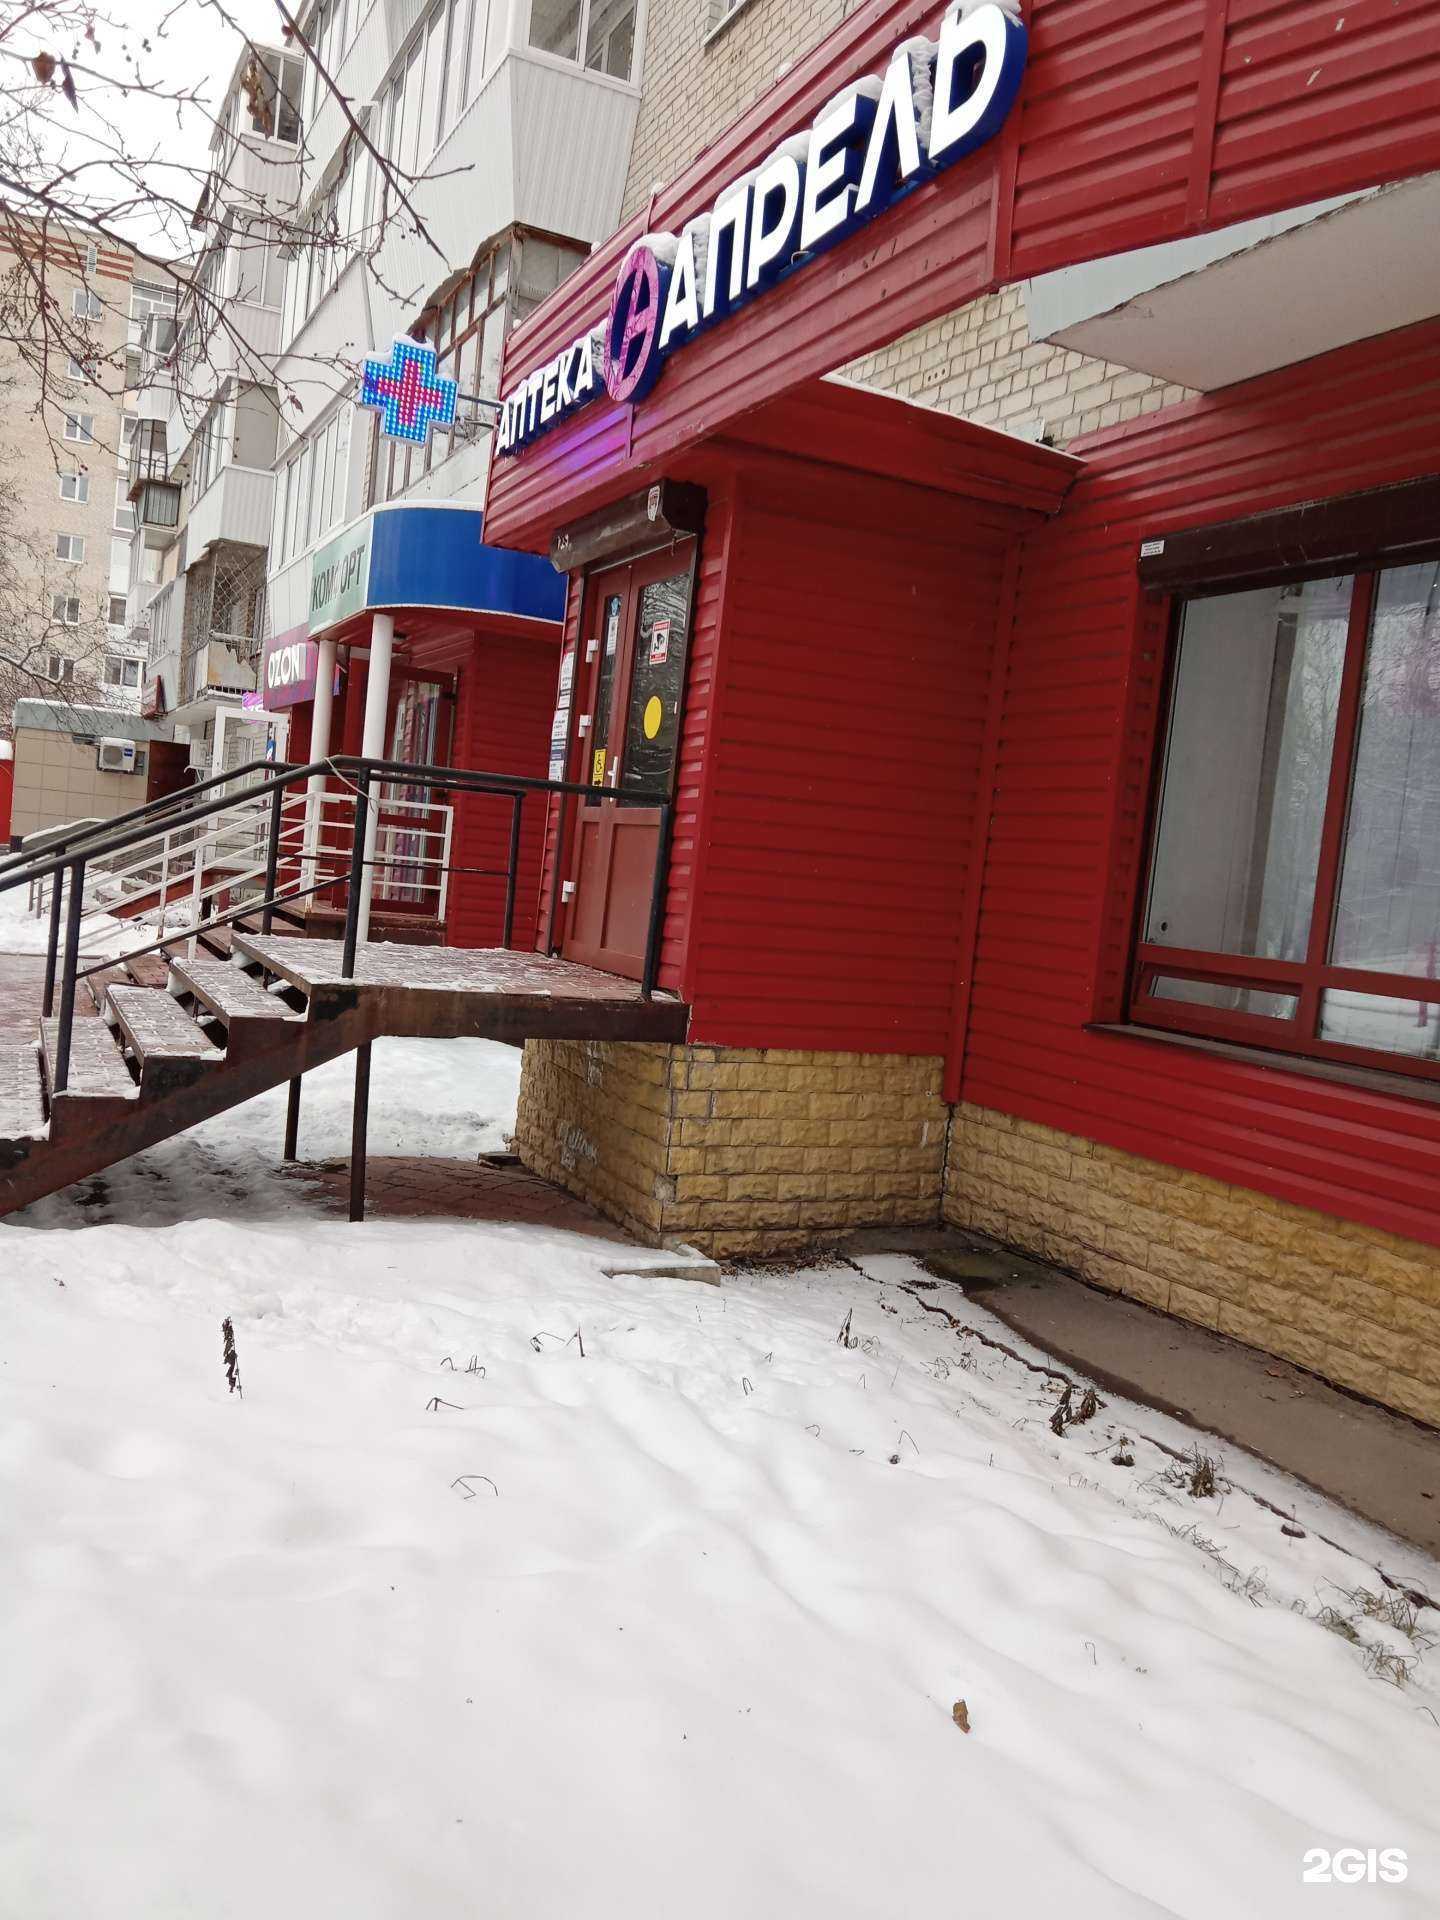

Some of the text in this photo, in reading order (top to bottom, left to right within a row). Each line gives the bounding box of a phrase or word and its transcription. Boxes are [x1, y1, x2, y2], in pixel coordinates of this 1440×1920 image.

[495, 4, 1008, 457] АПТЕКА АПРЕЛЬ
[311, 544, 366, 612] КОМОРТ
[267, 643, 306, 689] OZON
